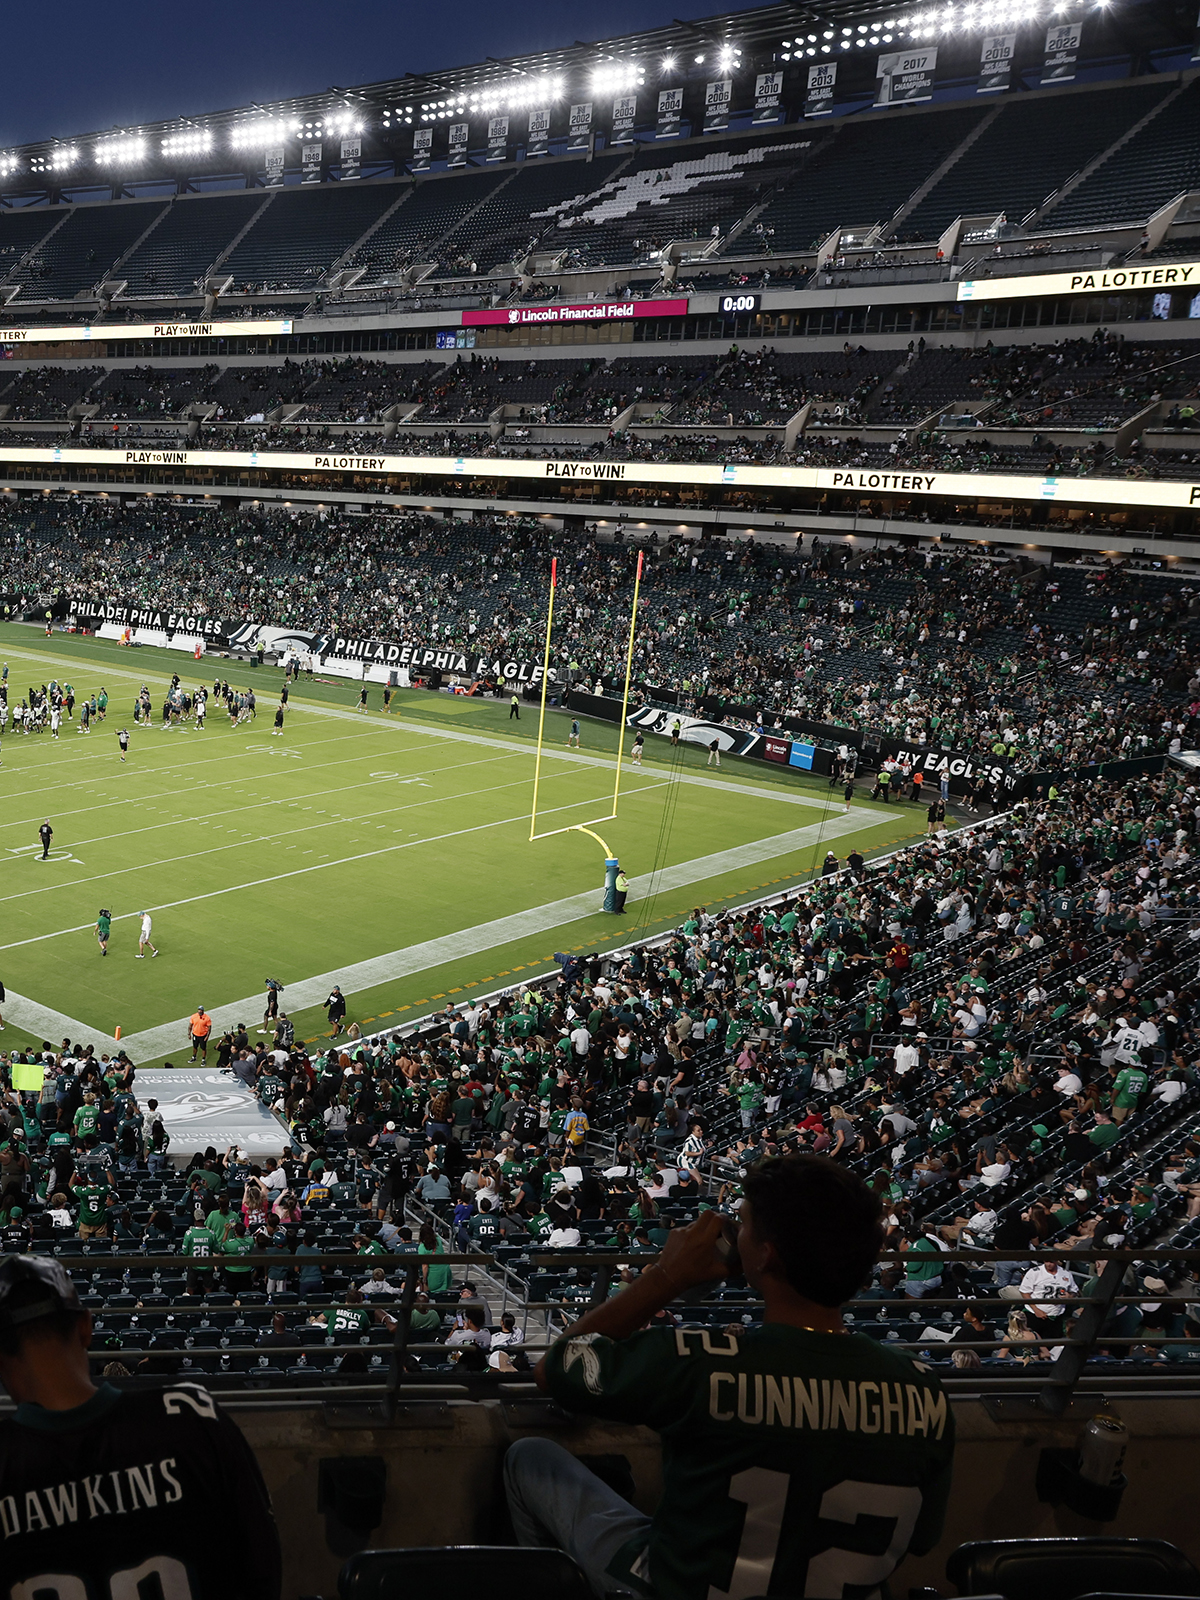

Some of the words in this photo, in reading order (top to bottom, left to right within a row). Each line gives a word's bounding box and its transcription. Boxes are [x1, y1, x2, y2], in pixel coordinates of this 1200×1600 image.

[1048, 36, 1078, 50] 2022
[985, 46, 1011, 60] 2019
[903, 57, 927, 70] 2017
[811, 75, 833, 87] 2013
[902, 72, 925, 82] WORLD
[758, 83, 779, 95] 2010
[894, 79, 931, 91] CHAMPIONS
[707, 91, 729, 103] 2006
[660, 99, 680, 111] 2004
[571, 113, 590, 124] 2002
[615, 107, 634, 118] 2003
[491, 126, 506, 136] 1988
[531, 120, 548, 130] 2001
[304, 153, 320, 161] 1948
[343, 148, 359, 157] 1949
[1070, 275, 1095, 290] PA
[1102, 267, 1194, 287] LOTTERY
[723, 296, 755, 312] 0:00
[522, 308, 558, 322] Lincoln
[559, 305, 606, 319] Financial
[608, 304, 634, 317] Field
[154, 325, 178, 336] PLAY
[188, 325, 213, 335] WIN!
[126, 452, 151, 463] PLAY
[162, 453, 187, 463] WIN!
[314, 457, 330, 467] PA
[333, 457, 386, 469] LOTTERY
[546, 463, 578, 477] PLAY
[580, 466, 591, 475] TO
[593, 465, 625, 478] WIN!
[833, 473, 855, 487] PA
[859, 474, 936, 491] LOTTERY
[167, 613, 222, 635] EAGLES
[334, 638, 467, 672] PHILADELPHIA
[476, 658, 558, 682] EAGLES
[896, 750, 921, 766] FLY
[1004, 774, 1017, 791] FLY
[1061, 901, 1068, 911] 6
[1123, 1038, 1138, 1051] 21
[265, 1084, 277, 1095] 33
[1127, 1081, 1143, 1093] 26
[83, 1117, 94, 1127] 62
[523, 1118, 532, 1129] 2
[300, 1132, 307, 1142] 6
[88, 1200, 99, 1212] 6
[192, 1245, 209, 1257] 26
[335, 1317, 360, 1329] 26
[709, 1371, 947, 1441] CUNNINGHAM
[707, 1466, 923, 1600] 12
